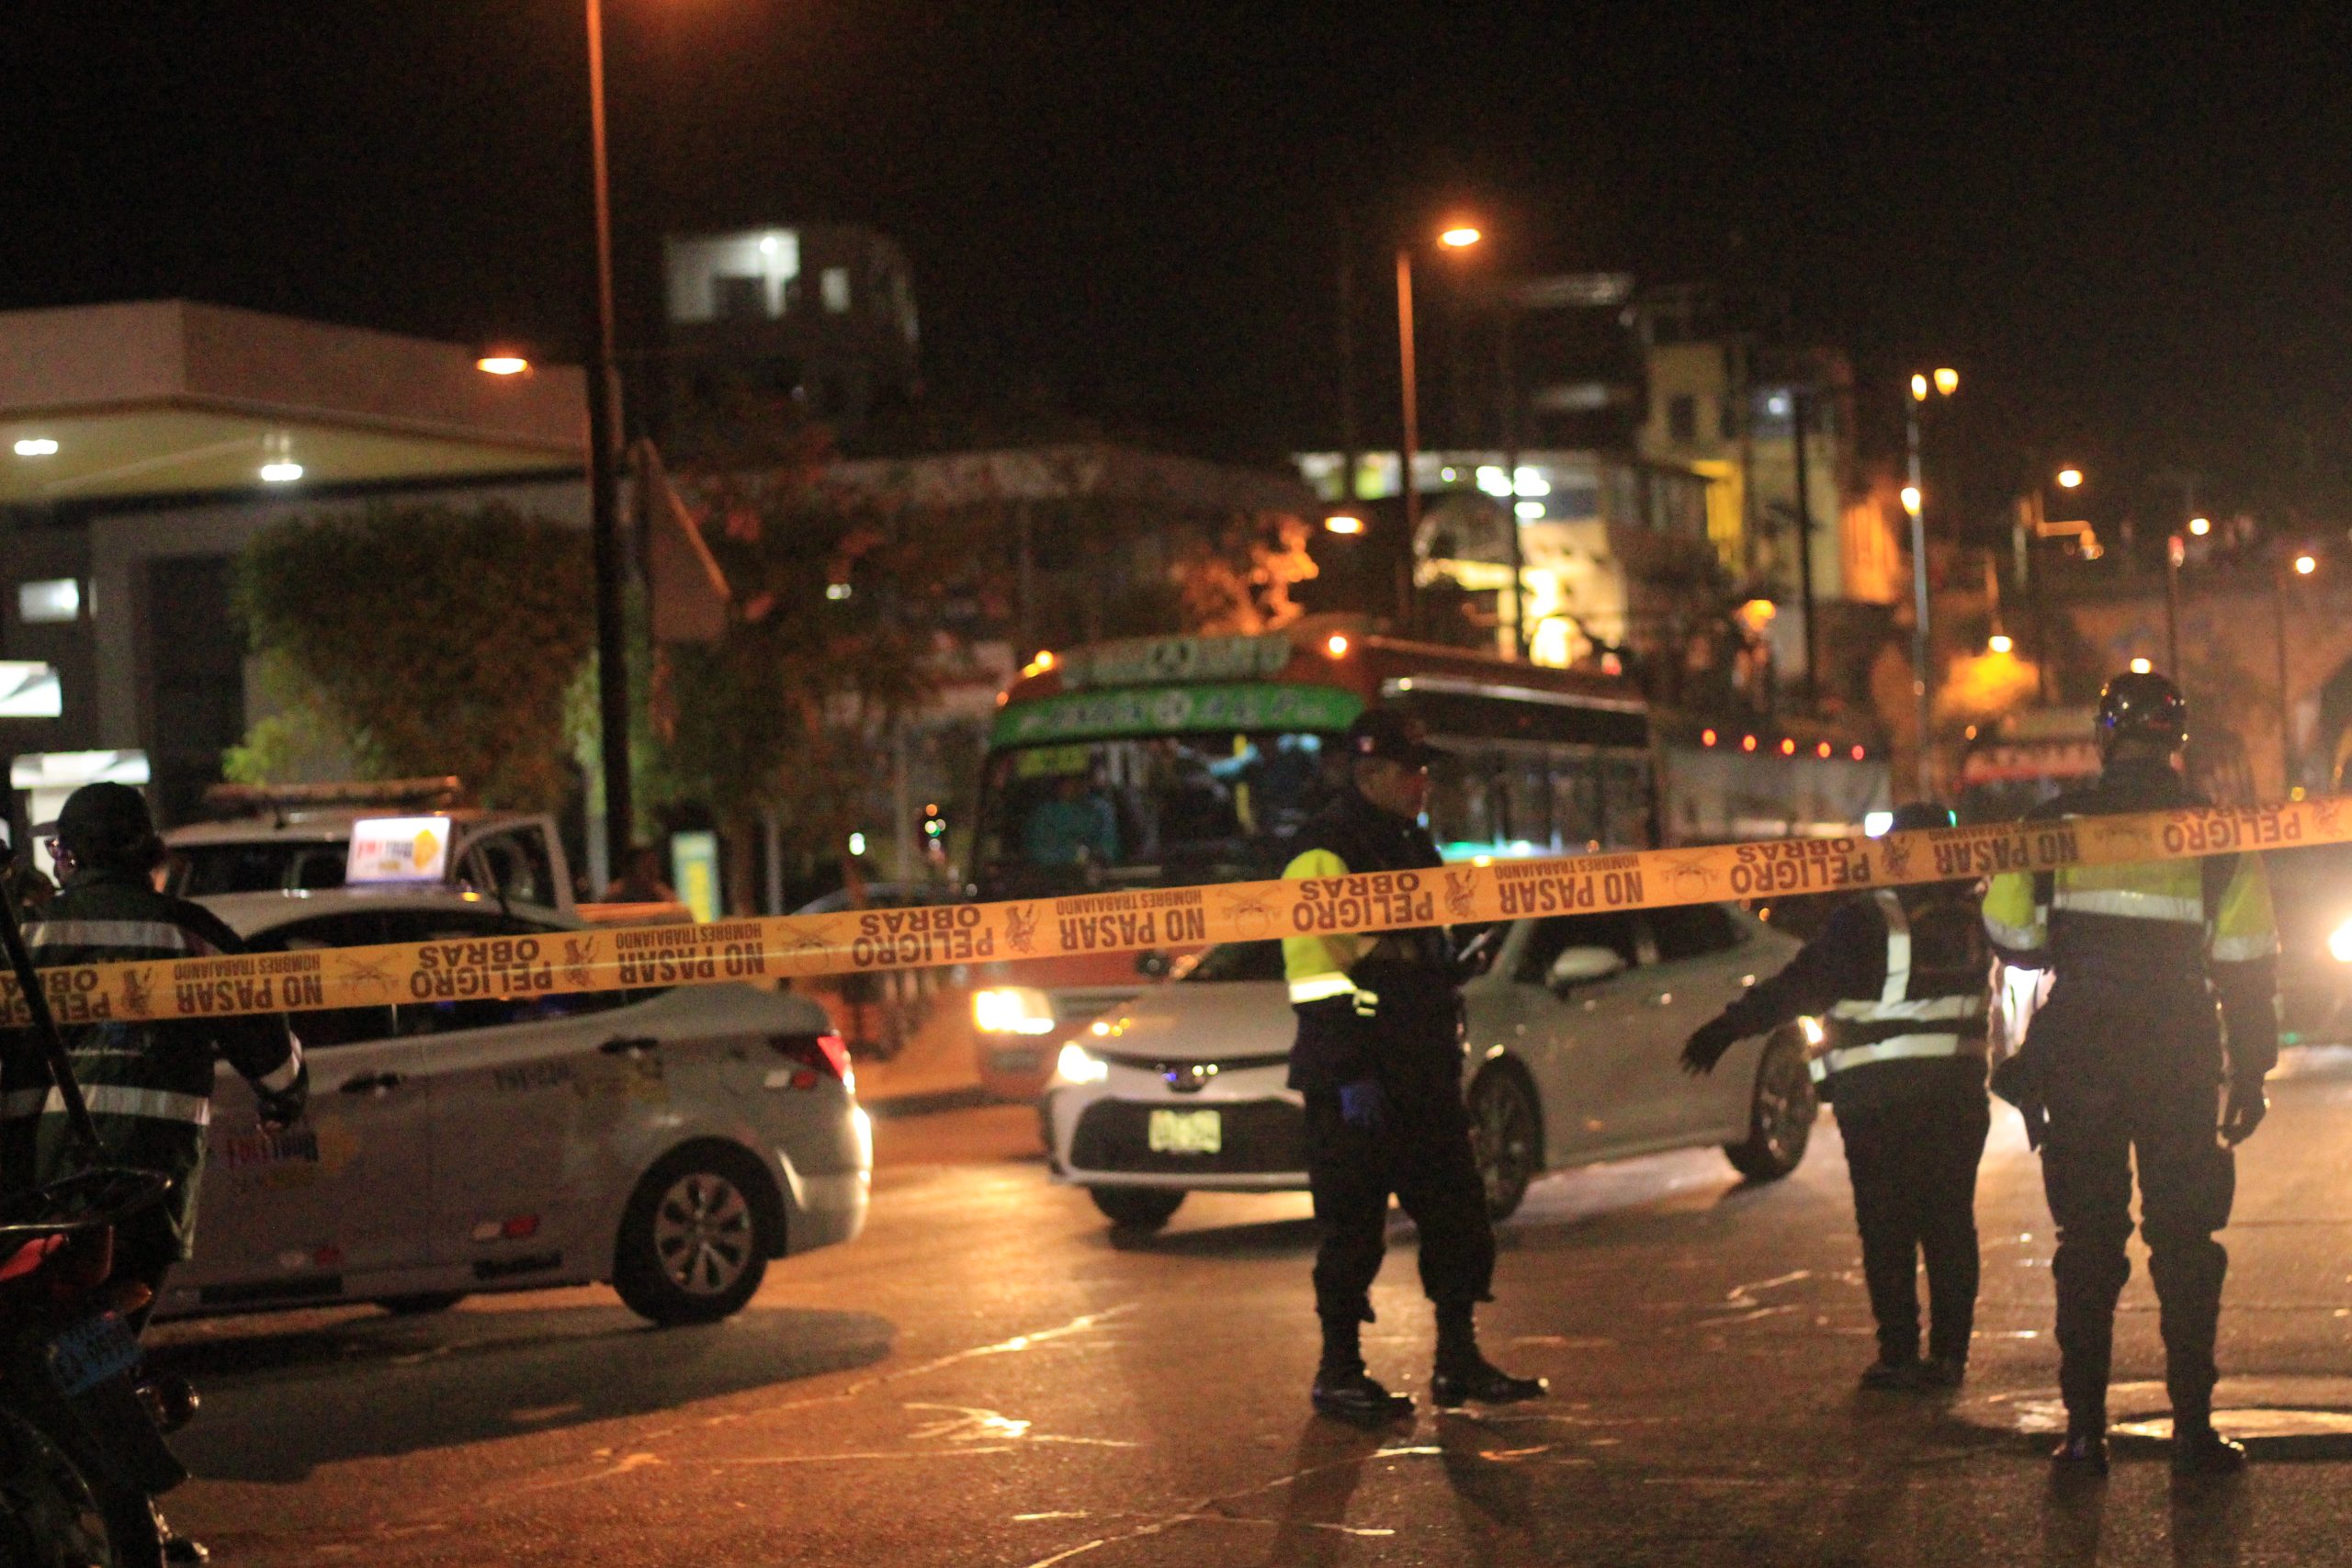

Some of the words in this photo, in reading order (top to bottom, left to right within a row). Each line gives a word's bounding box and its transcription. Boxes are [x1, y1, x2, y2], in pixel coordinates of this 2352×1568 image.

[2039, 829, 2079, 863] NO
[2164, 811, 2301, 853] PELIGRO
[1579, 853, 1640, 872] HOMBRES
[1736, 838, 1856, 864] OBRAS
[1934, 835, 2030, 874] PASAR
[1494, 858, 1576, 881] TRABAJANDO
[1730, 852, 1871, 895] PELIGRO
[1142, 888, 1204, 908] HOMBRES
[1300, 872, 1420, 901] OBRAS
[1499, 874, 1595, 915] PASAR
[1604, 871, 1645, 905] NO
[860, 905, 982, 936] OBRAS
[1056, 893, 1138, 915] TRABAJANDO
[1293, 891, 1435, 932] PELIGRO
[615, 928, 697, 949] TRABAJANDO
[701, 923, 763, 943] HOMBRES
[1059, 912, 1157, 951] PASAR
[1166, 908, 1206, 941] NO
[419, 938, 540, 967] OBRAS
[725, 942, 765, 976] NO
[853, 927, 994, 968] PELIGRO
[173, 959, 256, 981] TRABAJANDO
[410, 961, 554, 999] PELIGRO
[618, 949, 716, 985] PASAR
[176, 978, 275, 1012] PASAR
[283, 975, 324, 1007] NO
